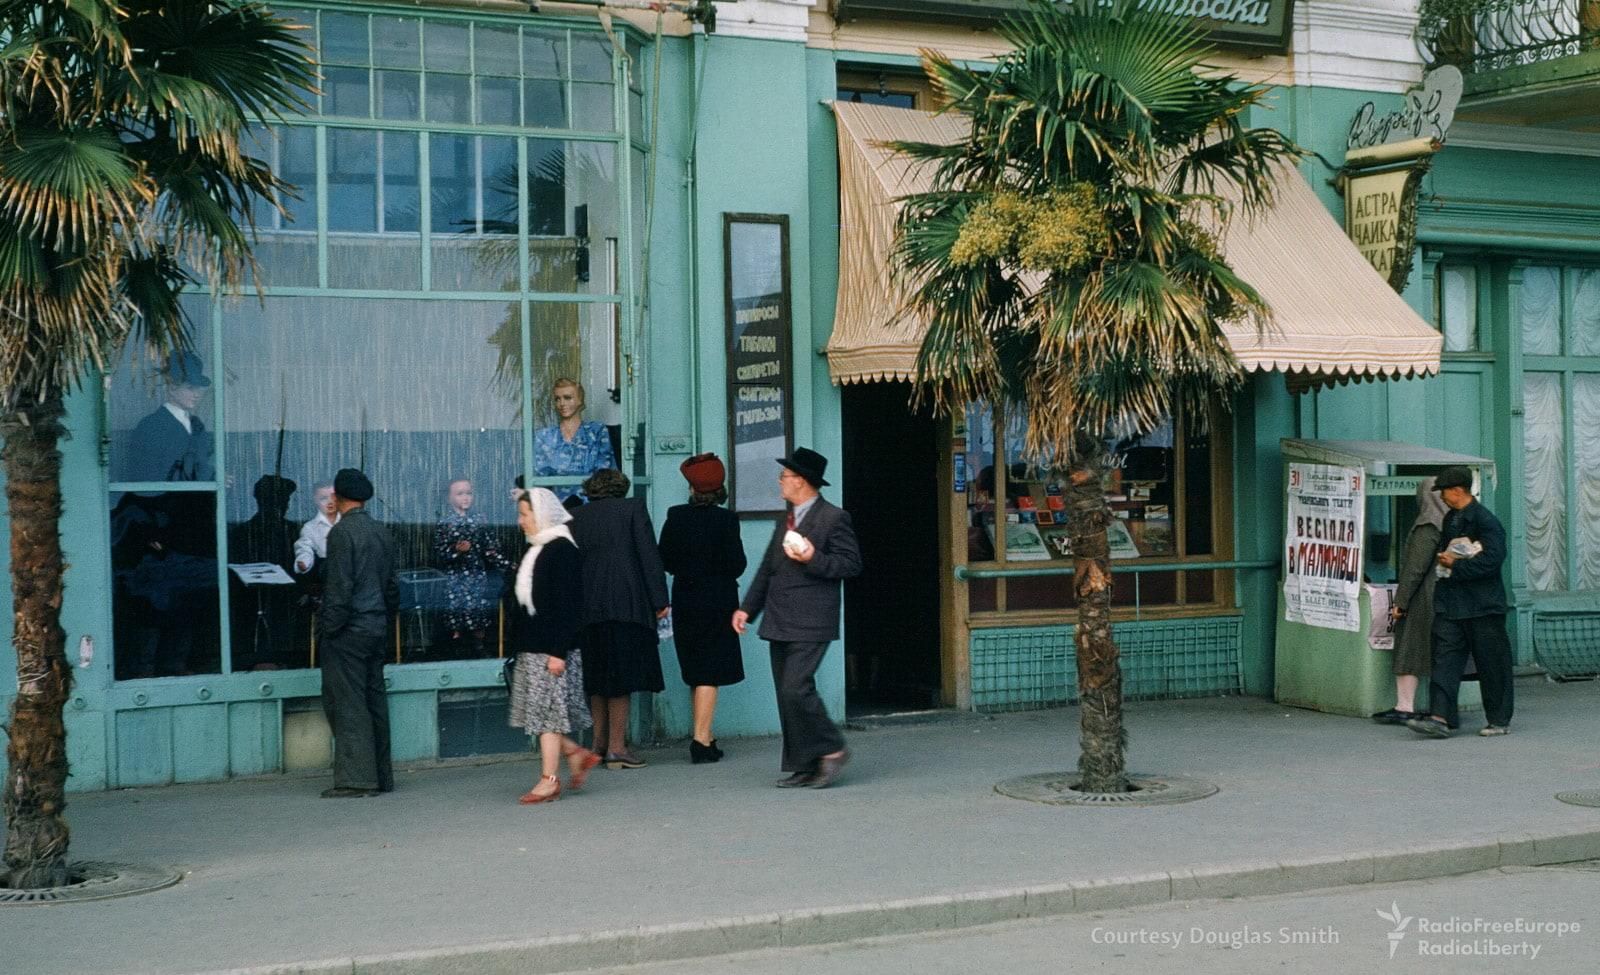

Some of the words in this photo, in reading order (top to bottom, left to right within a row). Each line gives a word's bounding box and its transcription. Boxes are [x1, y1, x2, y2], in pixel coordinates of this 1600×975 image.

[1355, 192, 1397, 219] АСТРА
[740, 335, 777, 352] ТАБАКИ
[738, 387, 781, 402] СИГАРЫ
[736, 405, 781, 426] ГИЛЬЗЫ
[1291, 470, 1300, 487] 31
[1352, 475, 1361, 491] 31
[1296, 515, 1355, 543] ВЕСІЛЛЯ
[1288, 545, 1295, 574] В
